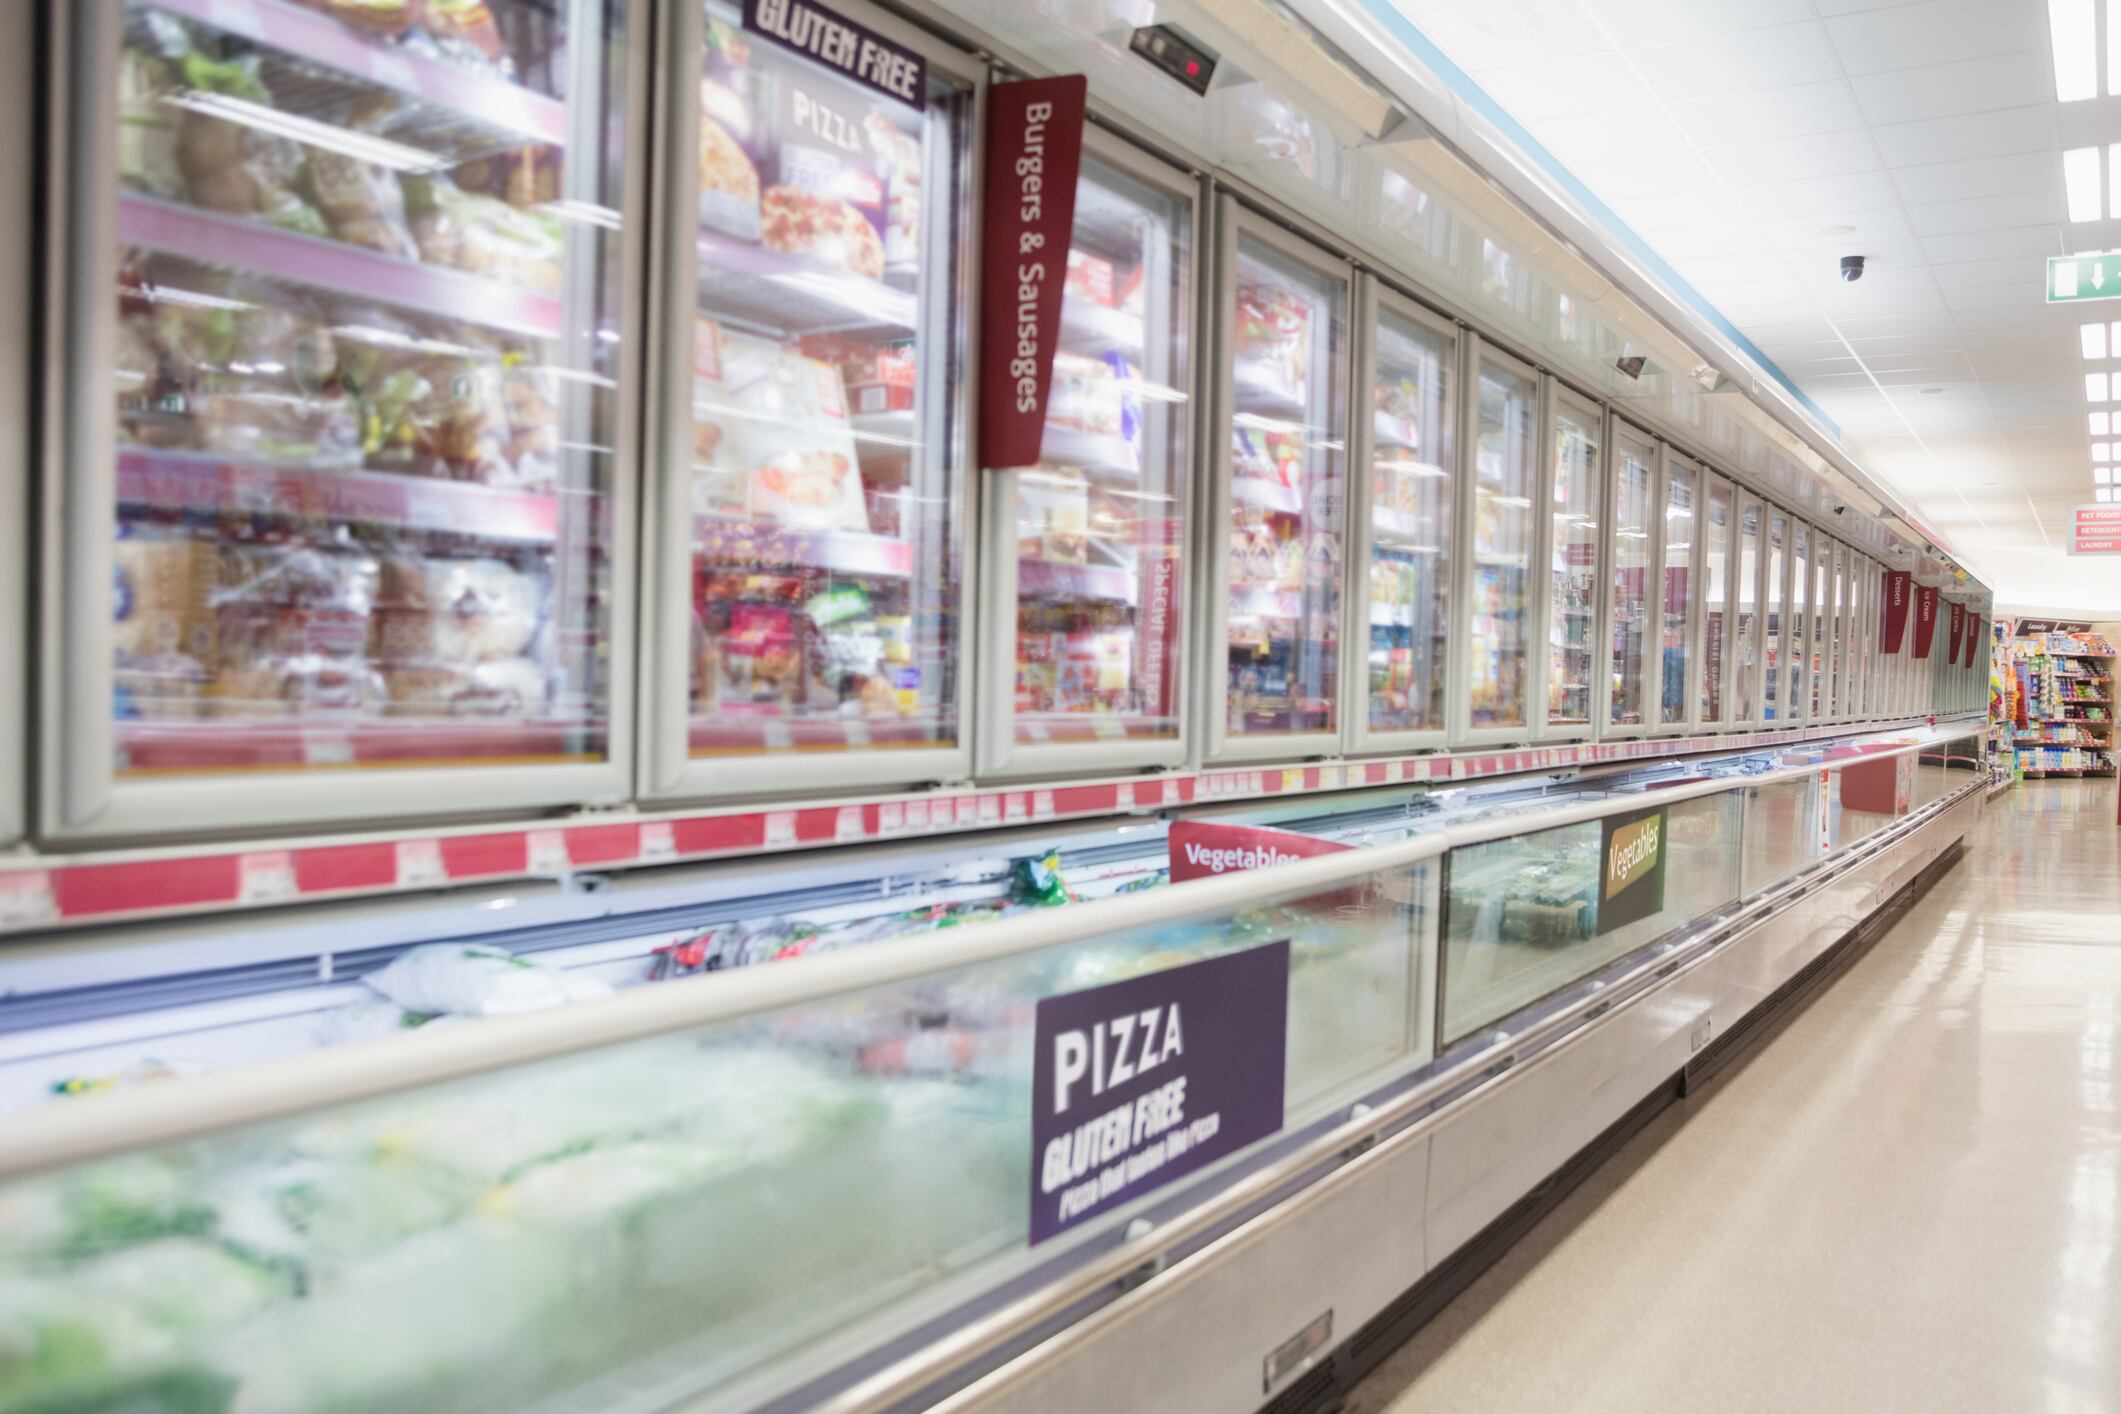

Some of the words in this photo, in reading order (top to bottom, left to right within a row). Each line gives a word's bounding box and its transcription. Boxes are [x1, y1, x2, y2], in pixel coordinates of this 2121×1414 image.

[755, 0, 858, 71] GLUTEN
[857, 38, 920, 100] FREE
[792, 87, 864, 155] PIZZA
[1015, 102, 1052, 224] Burgers
[1019, 231, 1045, 254] &
[1010, 262, 1045, 414] Sausages
[1894, 576, 1902, 606] Desserts
[1923, 601, 1931, 621] Cream
[1609, 821, 1659, 881] Vegetables
[1054, 1002, 1185, 1115] PIZZA
[1041, 1101, 1135, 1194] GLUTEN
[1132, 1074, 1188, 1147] FREE
